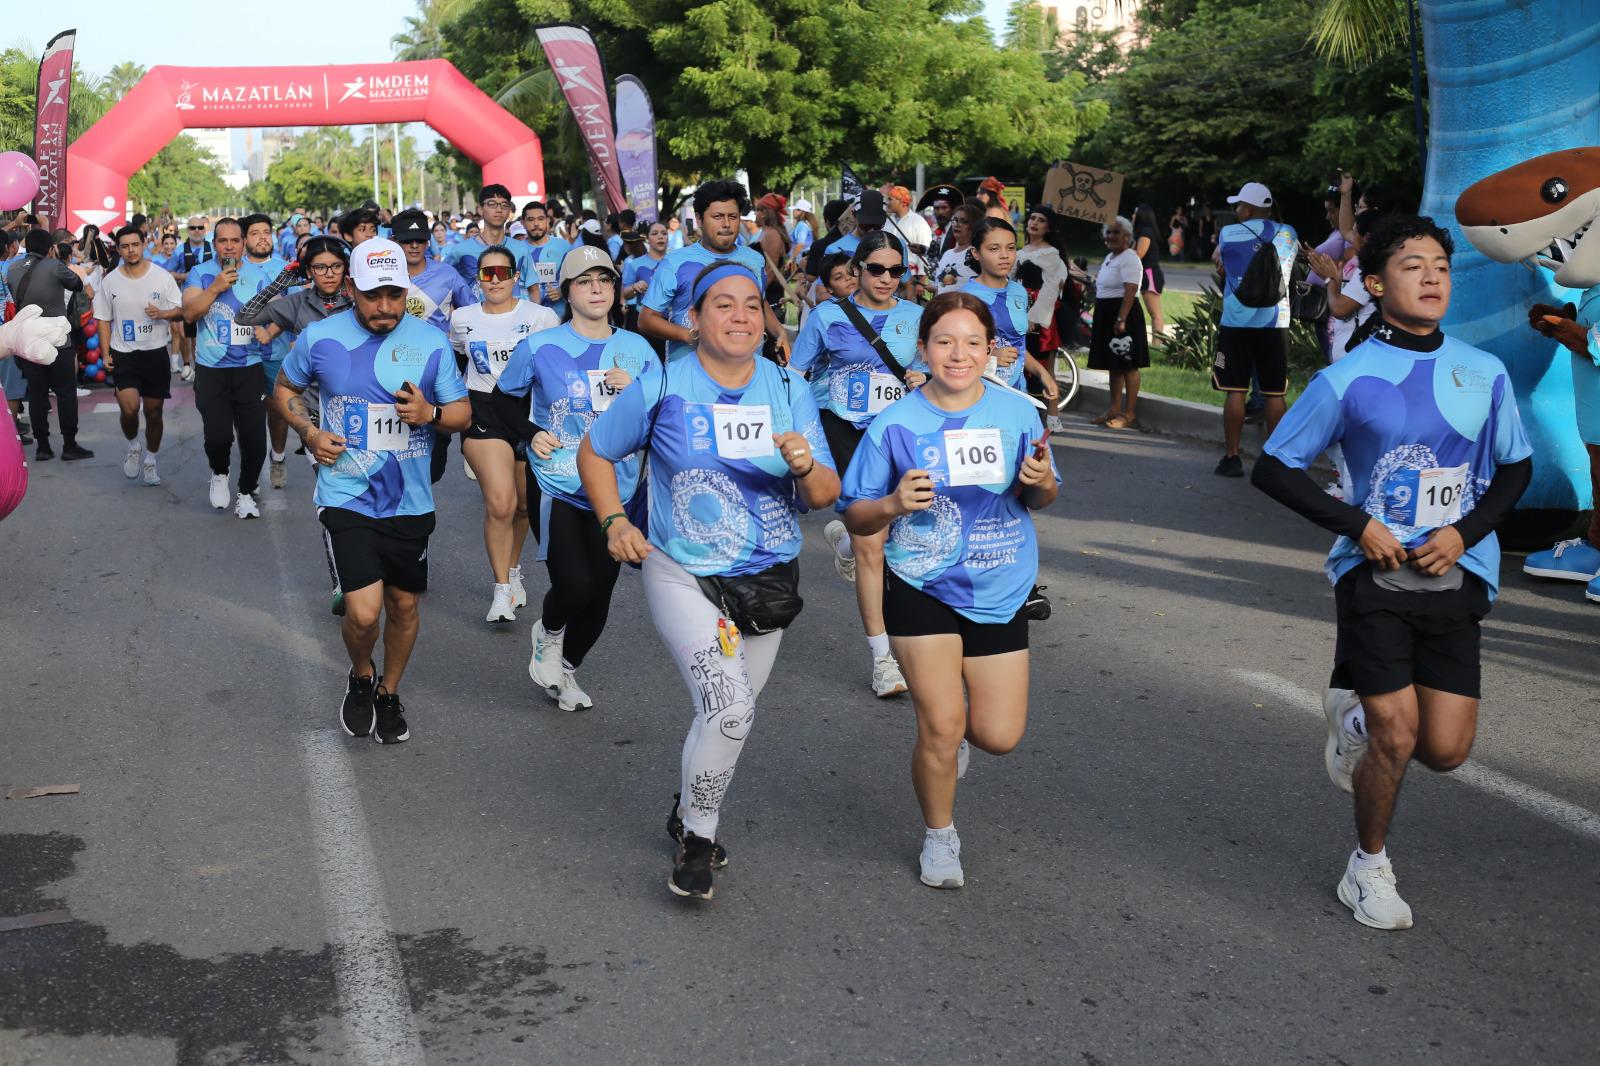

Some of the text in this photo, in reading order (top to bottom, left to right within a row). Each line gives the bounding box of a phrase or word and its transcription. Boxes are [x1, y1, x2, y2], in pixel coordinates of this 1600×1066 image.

[369, 74, 429, 89] IMDEM
[202, 82, 313, 102] MAZATLÁN
[38, 124, 51, 216] IMDEM
[539, 268, 554, 276] 104
[138, 324, 153, 334] 189
[235, 327, 251, 336] 100
[596, 381, 623, 396] 19
[874, 385, 902, 401] 168
[374, 417, 402, 434] 111
[722, 421, 764, 441] 107
[955, 445, 997, 466] 106
